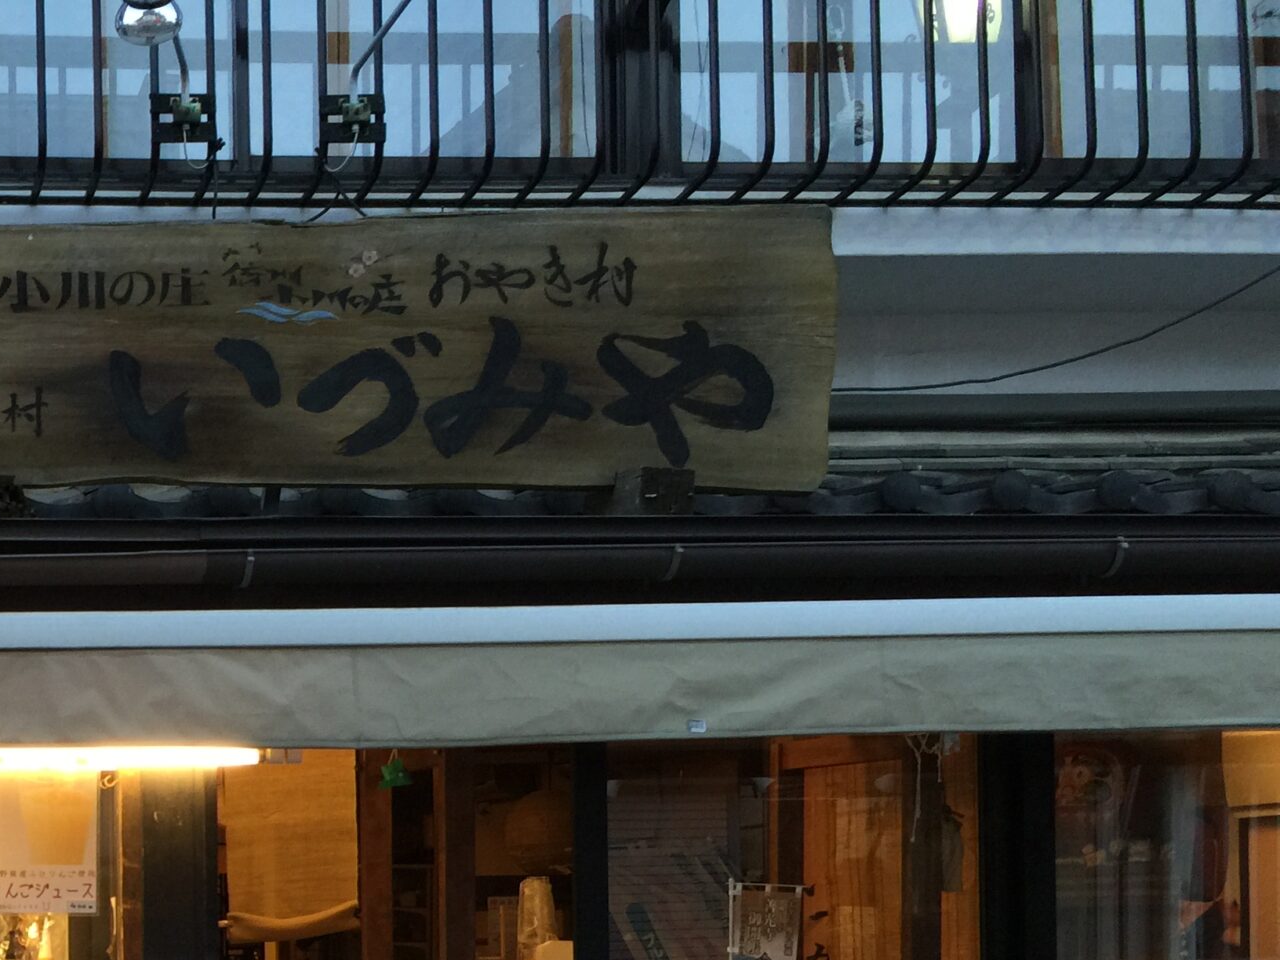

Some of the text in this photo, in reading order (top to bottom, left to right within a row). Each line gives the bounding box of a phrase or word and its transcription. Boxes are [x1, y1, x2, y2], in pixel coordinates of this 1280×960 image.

[428, 241, 638, 308] おやき村
[107, 316, 775, 468] いづみや
